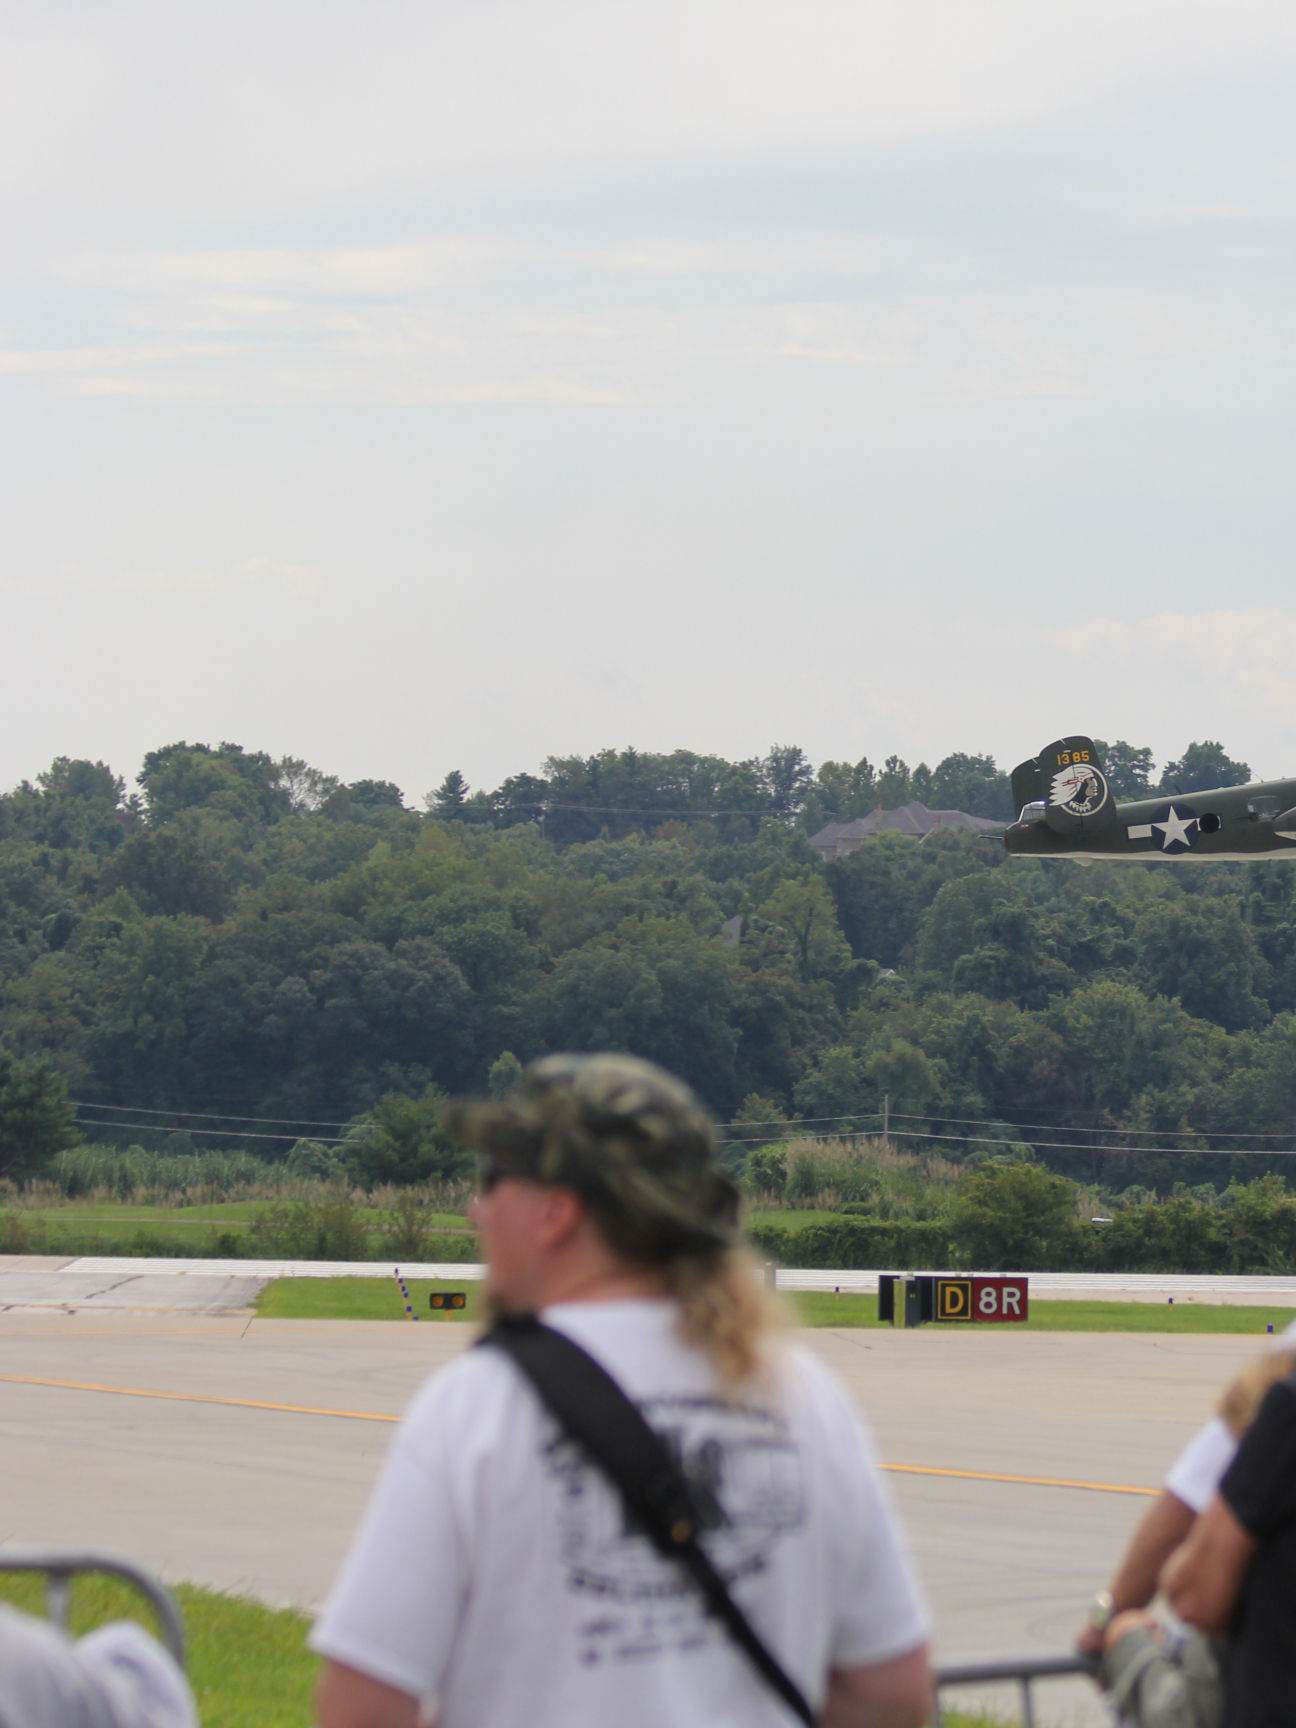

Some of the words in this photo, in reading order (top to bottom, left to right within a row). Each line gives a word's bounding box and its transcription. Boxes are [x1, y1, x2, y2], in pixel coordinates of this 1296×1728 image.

[1057, 750, 1090, 765] 1385
[945, 1286, 964, 1314] D
[978, 1286, 1021, 1315] 8R
